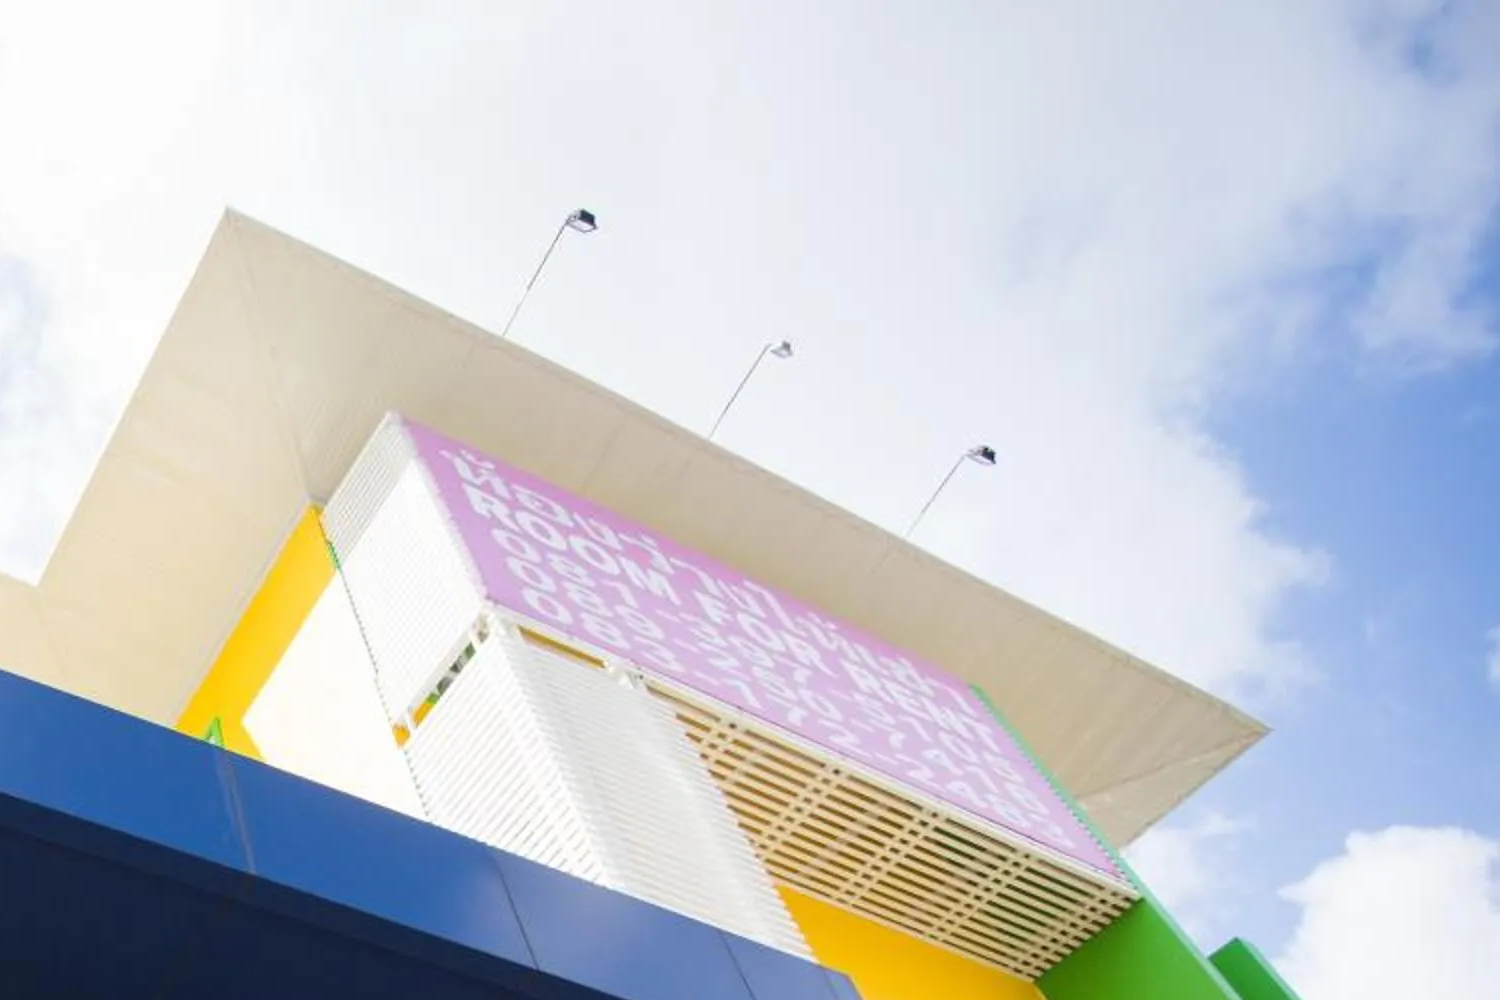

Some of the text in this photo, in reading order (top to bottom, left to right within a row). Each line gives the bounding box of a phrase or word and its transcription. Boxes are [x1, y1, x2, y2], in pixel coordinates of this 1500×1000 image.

[463, 480, 1006, 757] ROOM FOR RENT
